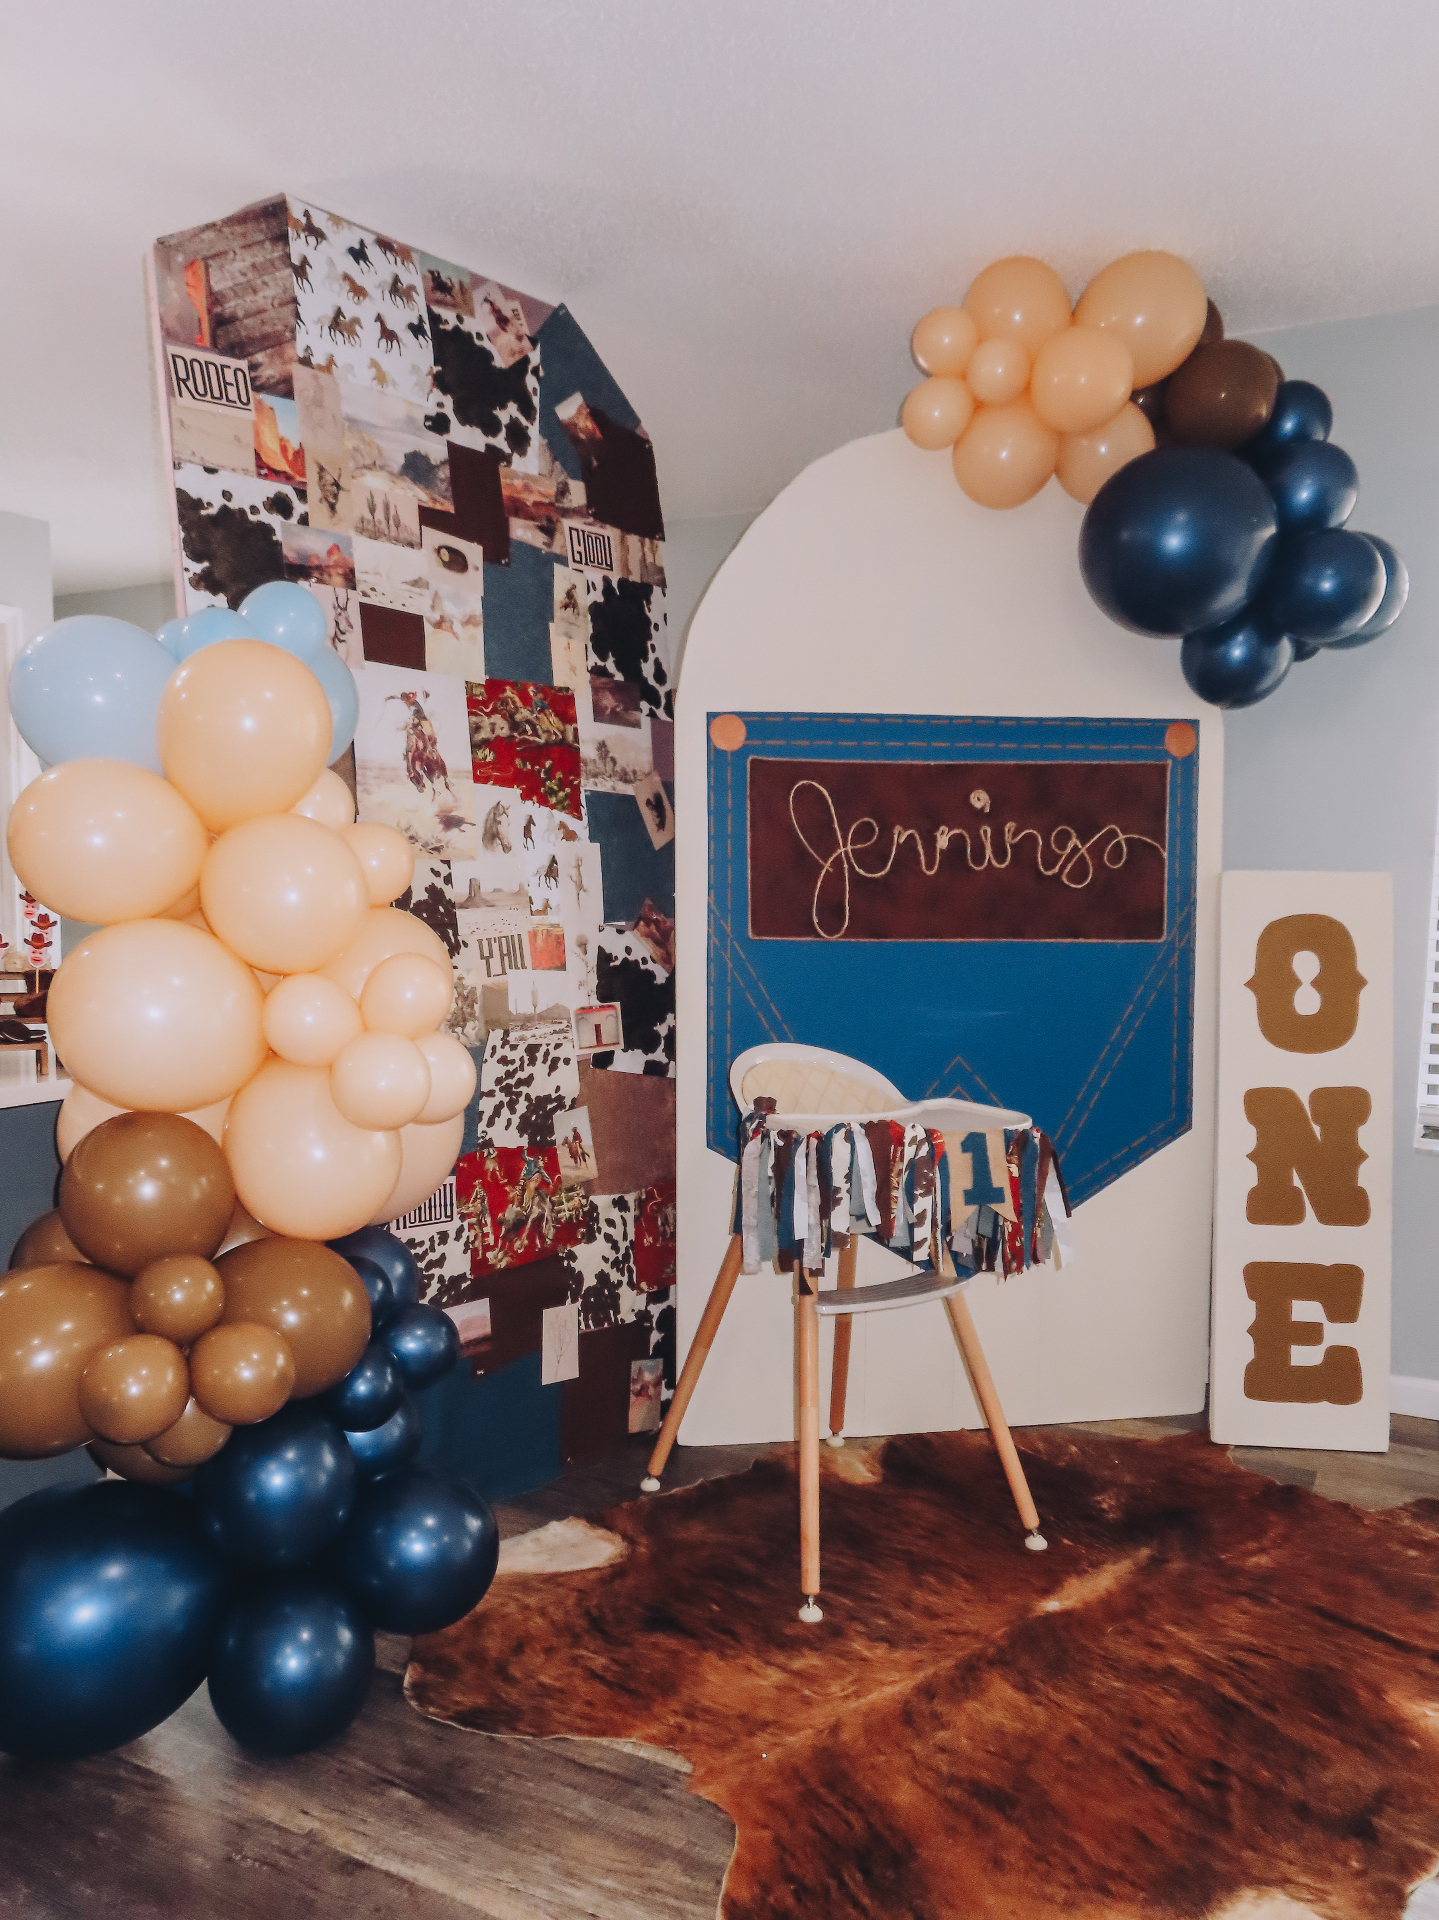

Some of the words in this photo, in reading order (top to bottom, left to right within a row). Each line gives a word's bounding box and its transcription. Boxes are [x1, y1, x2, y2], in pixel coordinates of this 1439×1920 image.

[171, 353, 252, 411] RODEO
[789, 780, 1167, 939] Jennings
[477, 933, 527, 978] Y'ALL
[961, 1131, 1005, 1206] 1
[1243, 912, 1372, 1405] ONE
